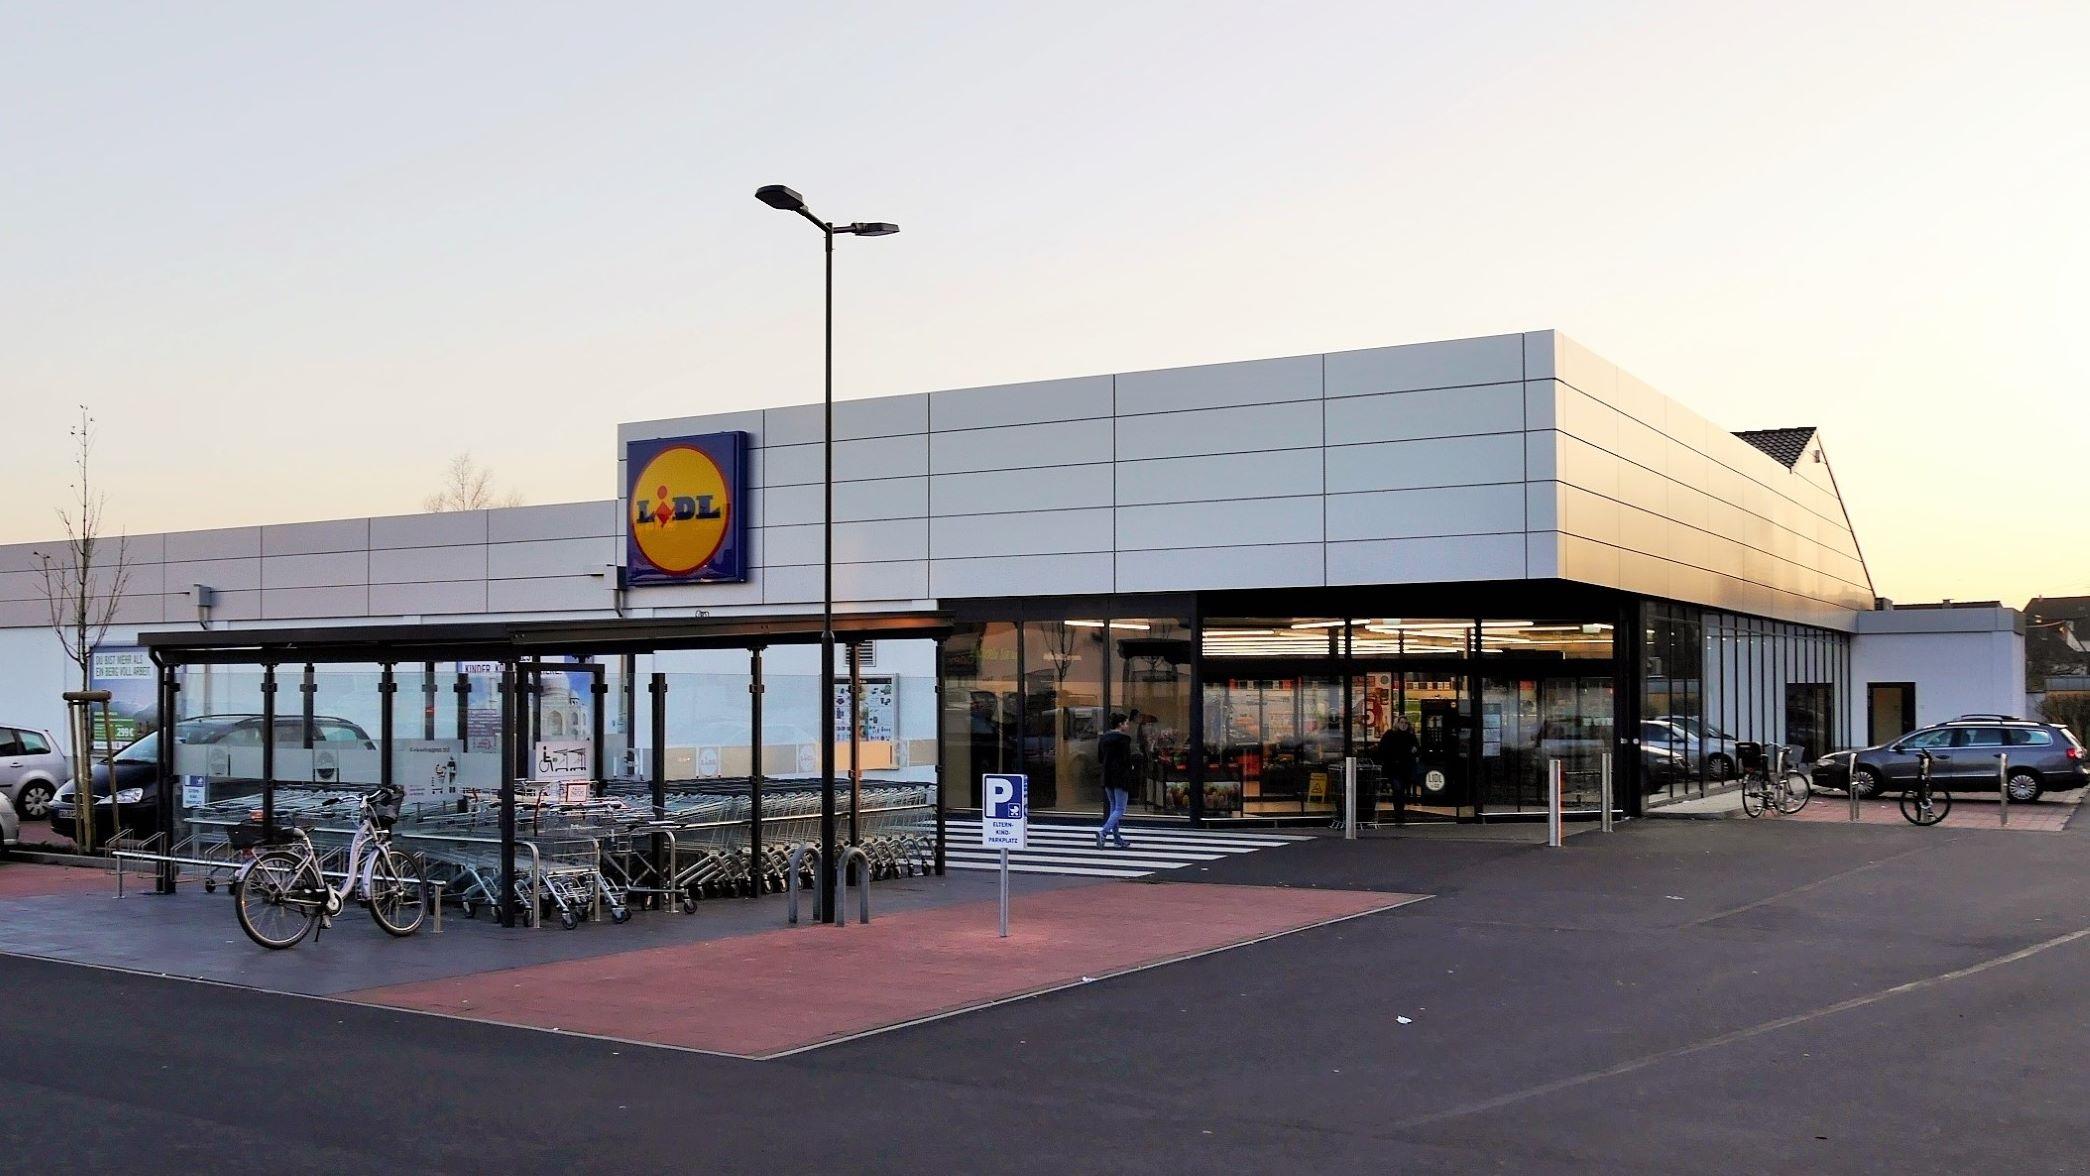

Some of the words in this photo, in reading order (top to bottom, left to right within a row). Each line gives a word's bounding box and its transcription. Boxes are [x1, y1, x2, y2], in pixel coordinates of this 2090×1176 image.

[105, 655, 116, 664] BIST
[117, 655, 132, 664] MEHR
[134, 654, 143, 664] ALS
[465, 664, 490, 672] KINDER
[986, 778, 1014, 816] P
